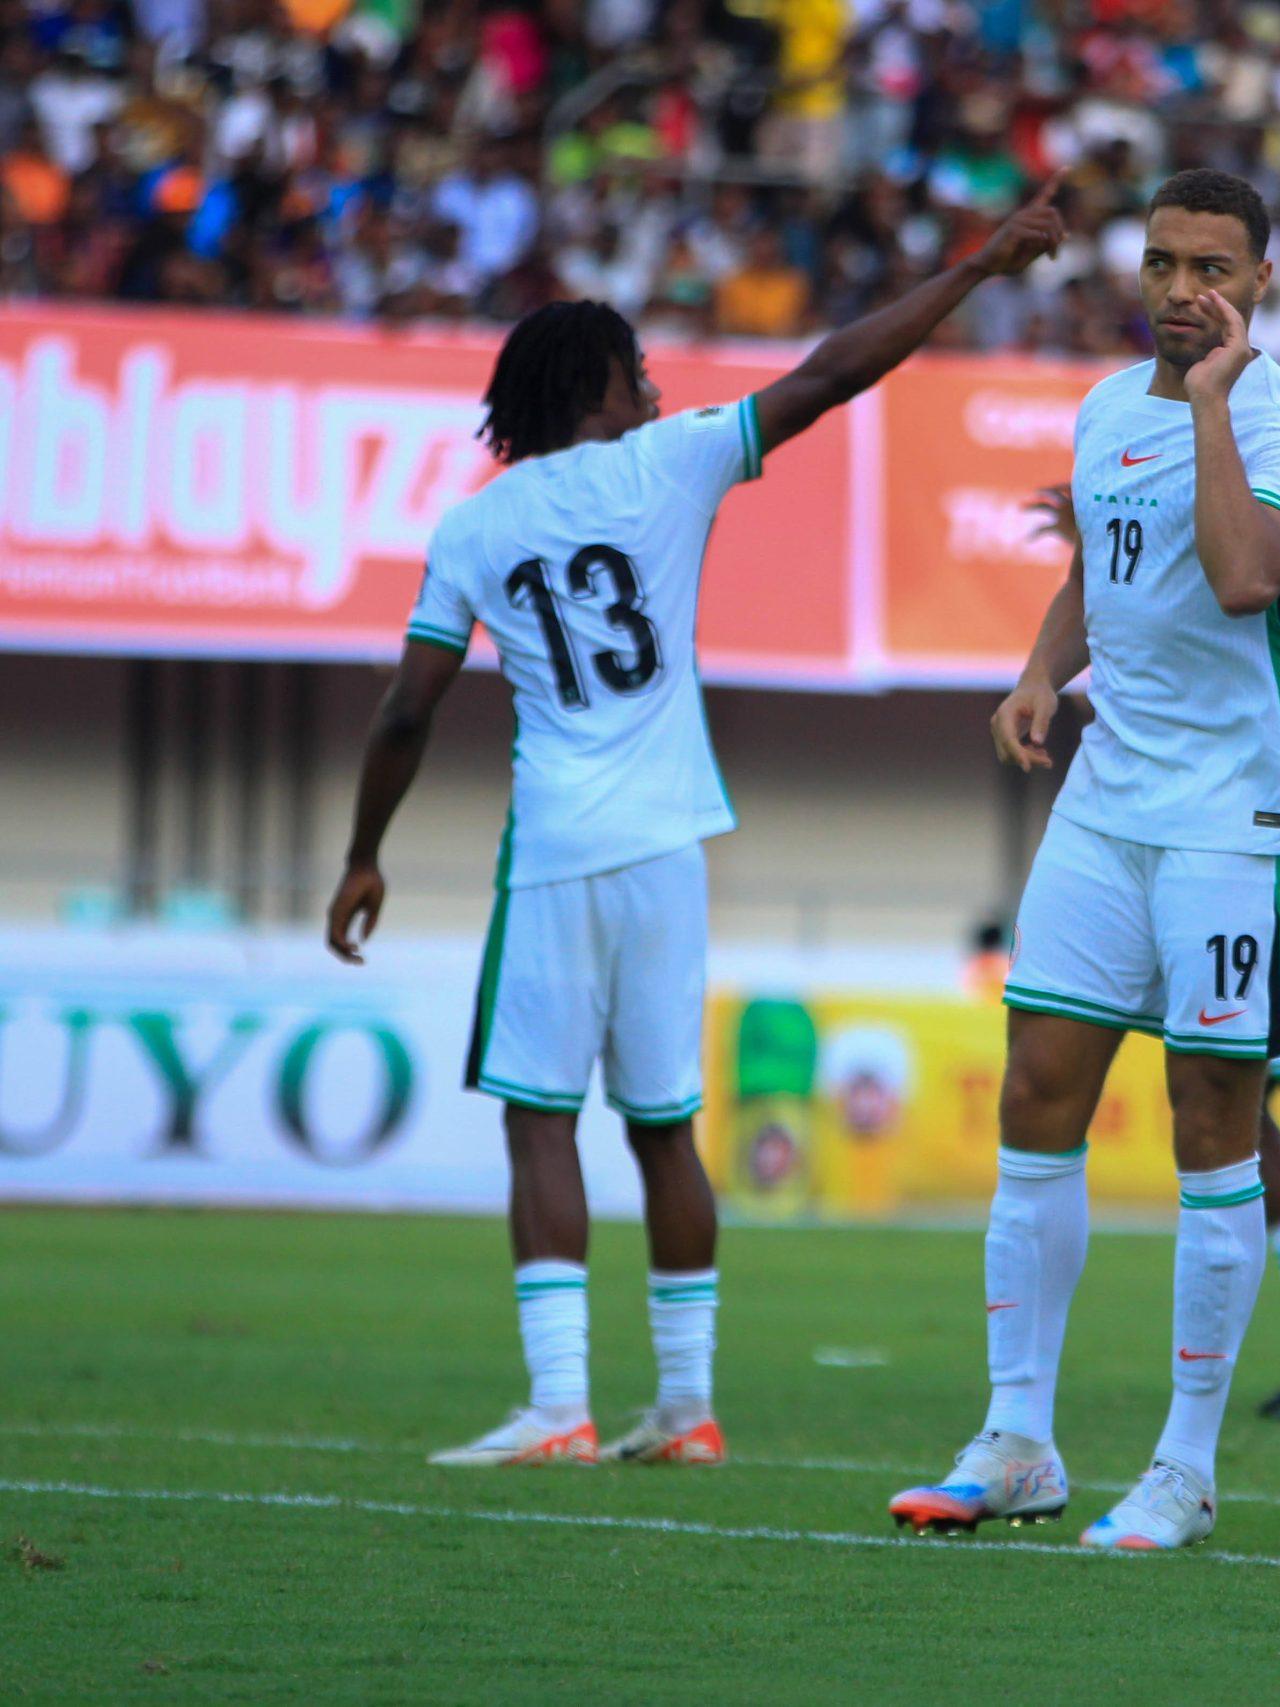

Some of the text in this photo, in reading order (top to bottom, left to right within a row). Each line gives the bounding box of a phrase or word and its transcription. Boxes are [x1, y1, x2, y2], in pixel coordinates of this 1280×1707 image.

[1106, 518, 1143, 585] 19
[504, 544, 665, 712] 13
[1206, 934, 1259, 1001] 19
